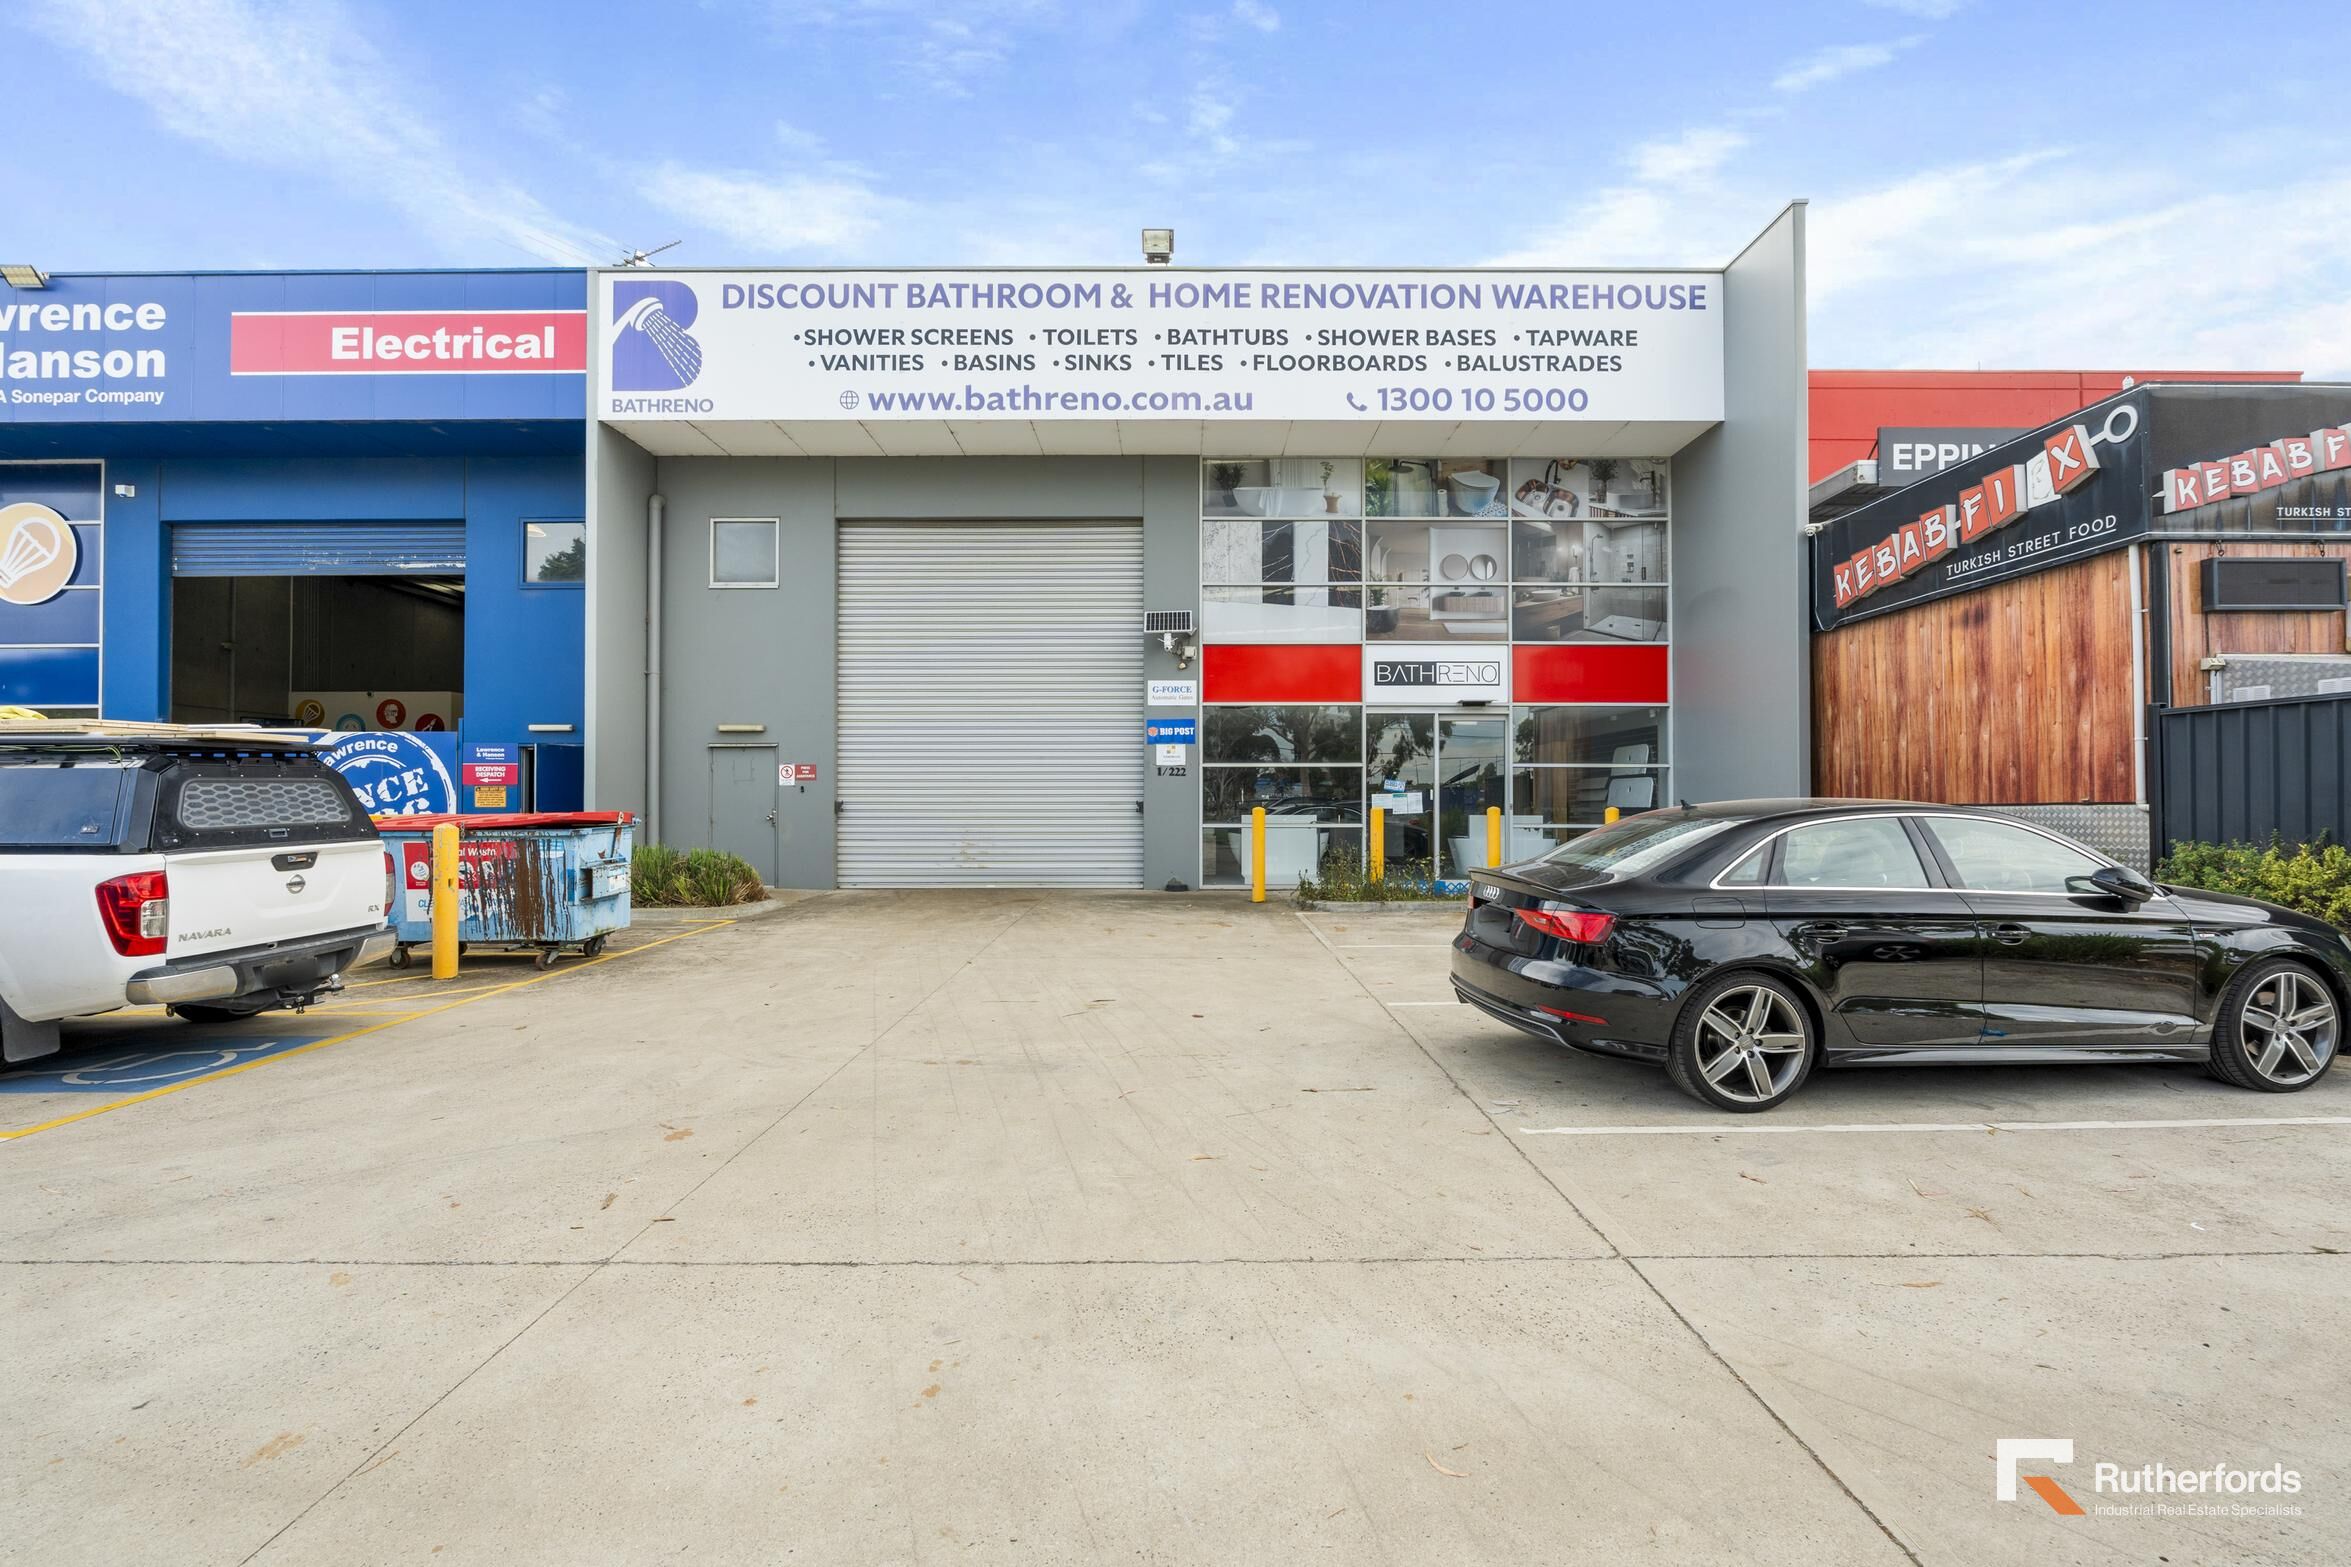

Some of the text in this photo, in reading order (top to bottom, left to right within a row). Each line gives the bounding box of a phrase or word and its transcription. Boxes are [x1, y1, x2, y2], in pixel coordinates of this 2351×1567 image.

[722, 282, 1707, 311] DISCOUNT BATHROOM & HOME RENOVATION WAREHOUSE
[331, 325, 555, 360] Electrical
[804, 328, 1638, 347] SHOWER SCREENS TOILETS BATHTUBS SHOWER BASES TAPWARE
[0, 341, 166, 380] anson
[820, 354, 1623, 372] VANITIES BASINS SINKS TILES FLOORBOARDS BALUSTRADES
[11, 389, 82, 407] Sonepar
[85, 388, 165, 406] Company
[612, 398, 714, 413] BATHRENO
[867, 384, 1253, 412] www.bathreno.com.au
[1377, 387, 1589, 412] 1300 10 5000
[2177, 441, 2313, 505] KEBAB
[2276, 507, 2331, 517] TURKISH
[1946, 515, 2118, 576] TURKISH STREET FOOD
[1835, 513, 1947, 600] KEBAB
[1376, 664, 1498, 683] BATHRENO
[1152, 685, 1192, 693] G-FORCE
[1159, 727, 1194, 736] BIG POST
[323, 740, 398, 767] awrence
[1157, 766, 1187, 777] 1/222
[178, 927, 232, 942] NAVARA
